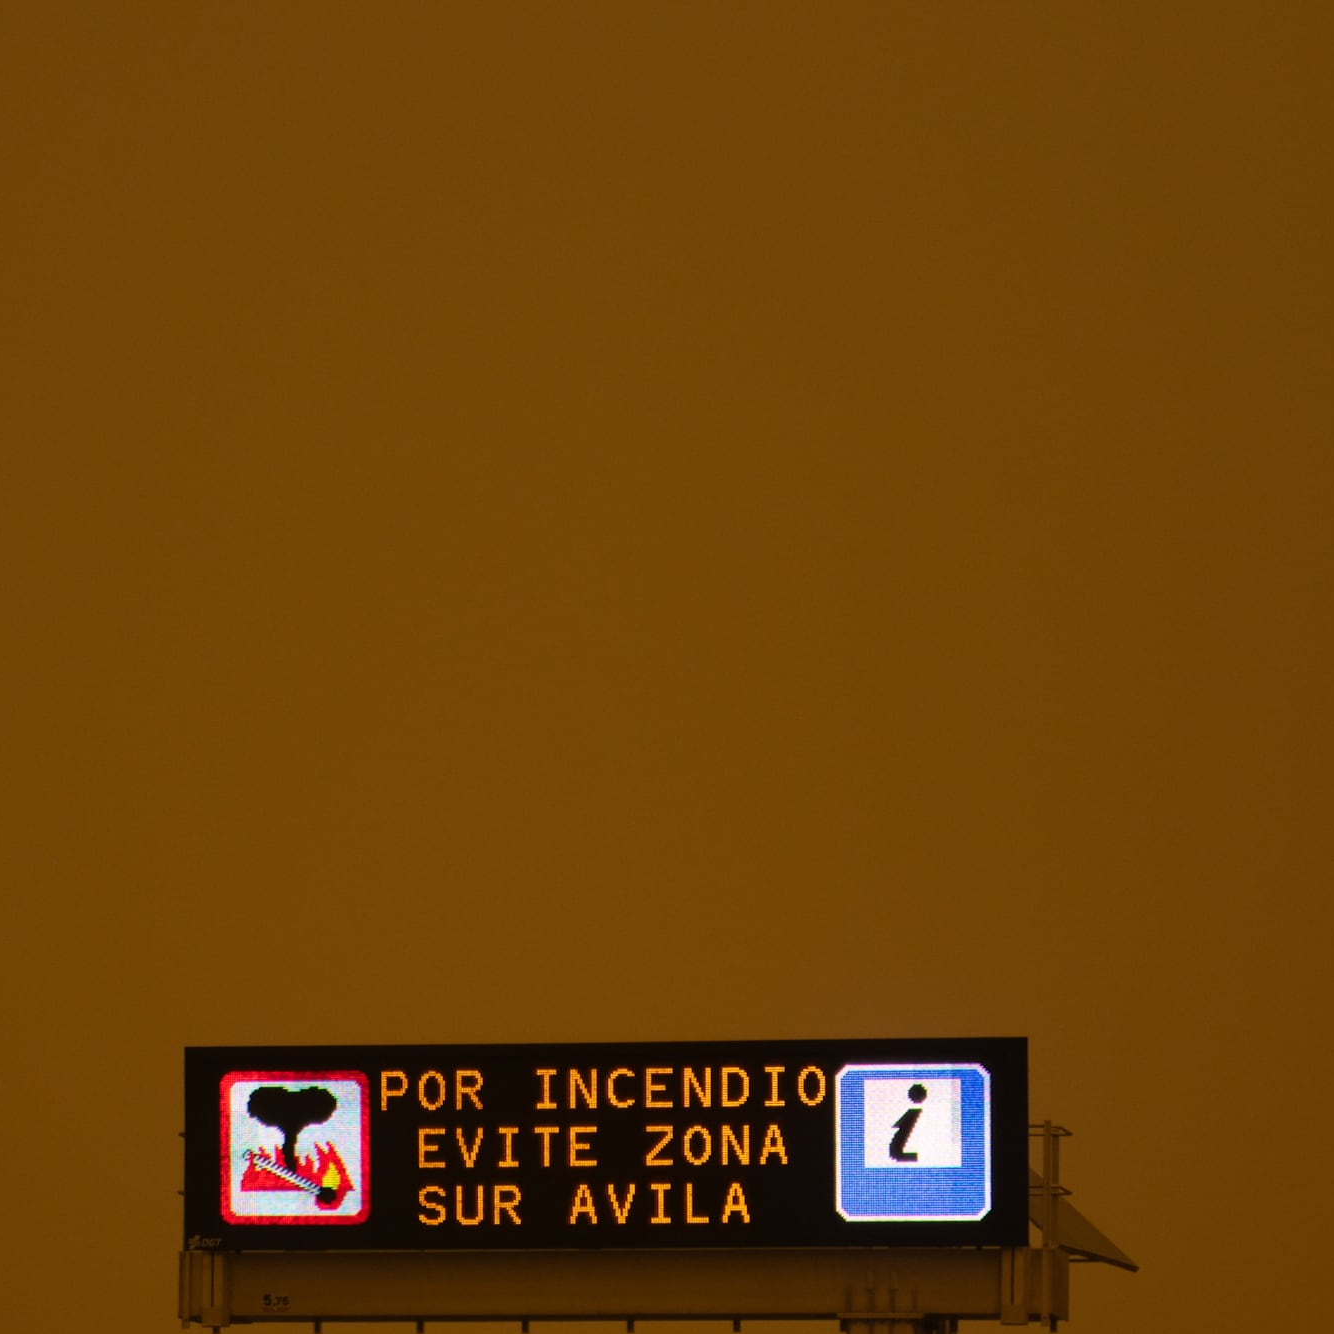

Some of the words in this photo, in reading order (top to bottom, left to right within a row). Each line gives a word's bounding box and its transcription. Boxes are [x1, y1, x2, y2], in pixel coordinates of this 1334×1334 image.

[380, 1069, 484, 1112] POR
[535, 1065, 827, 1110] INCENDIO
[418, 1125, 598, 1169] EVITE
[645, 1123, 789, 1167] ZONA
[418, 1184, 522, 1226] SUR
[569, 1181, 751, 1225] AVILA
[201, 1237, 222, 1248] DGT
